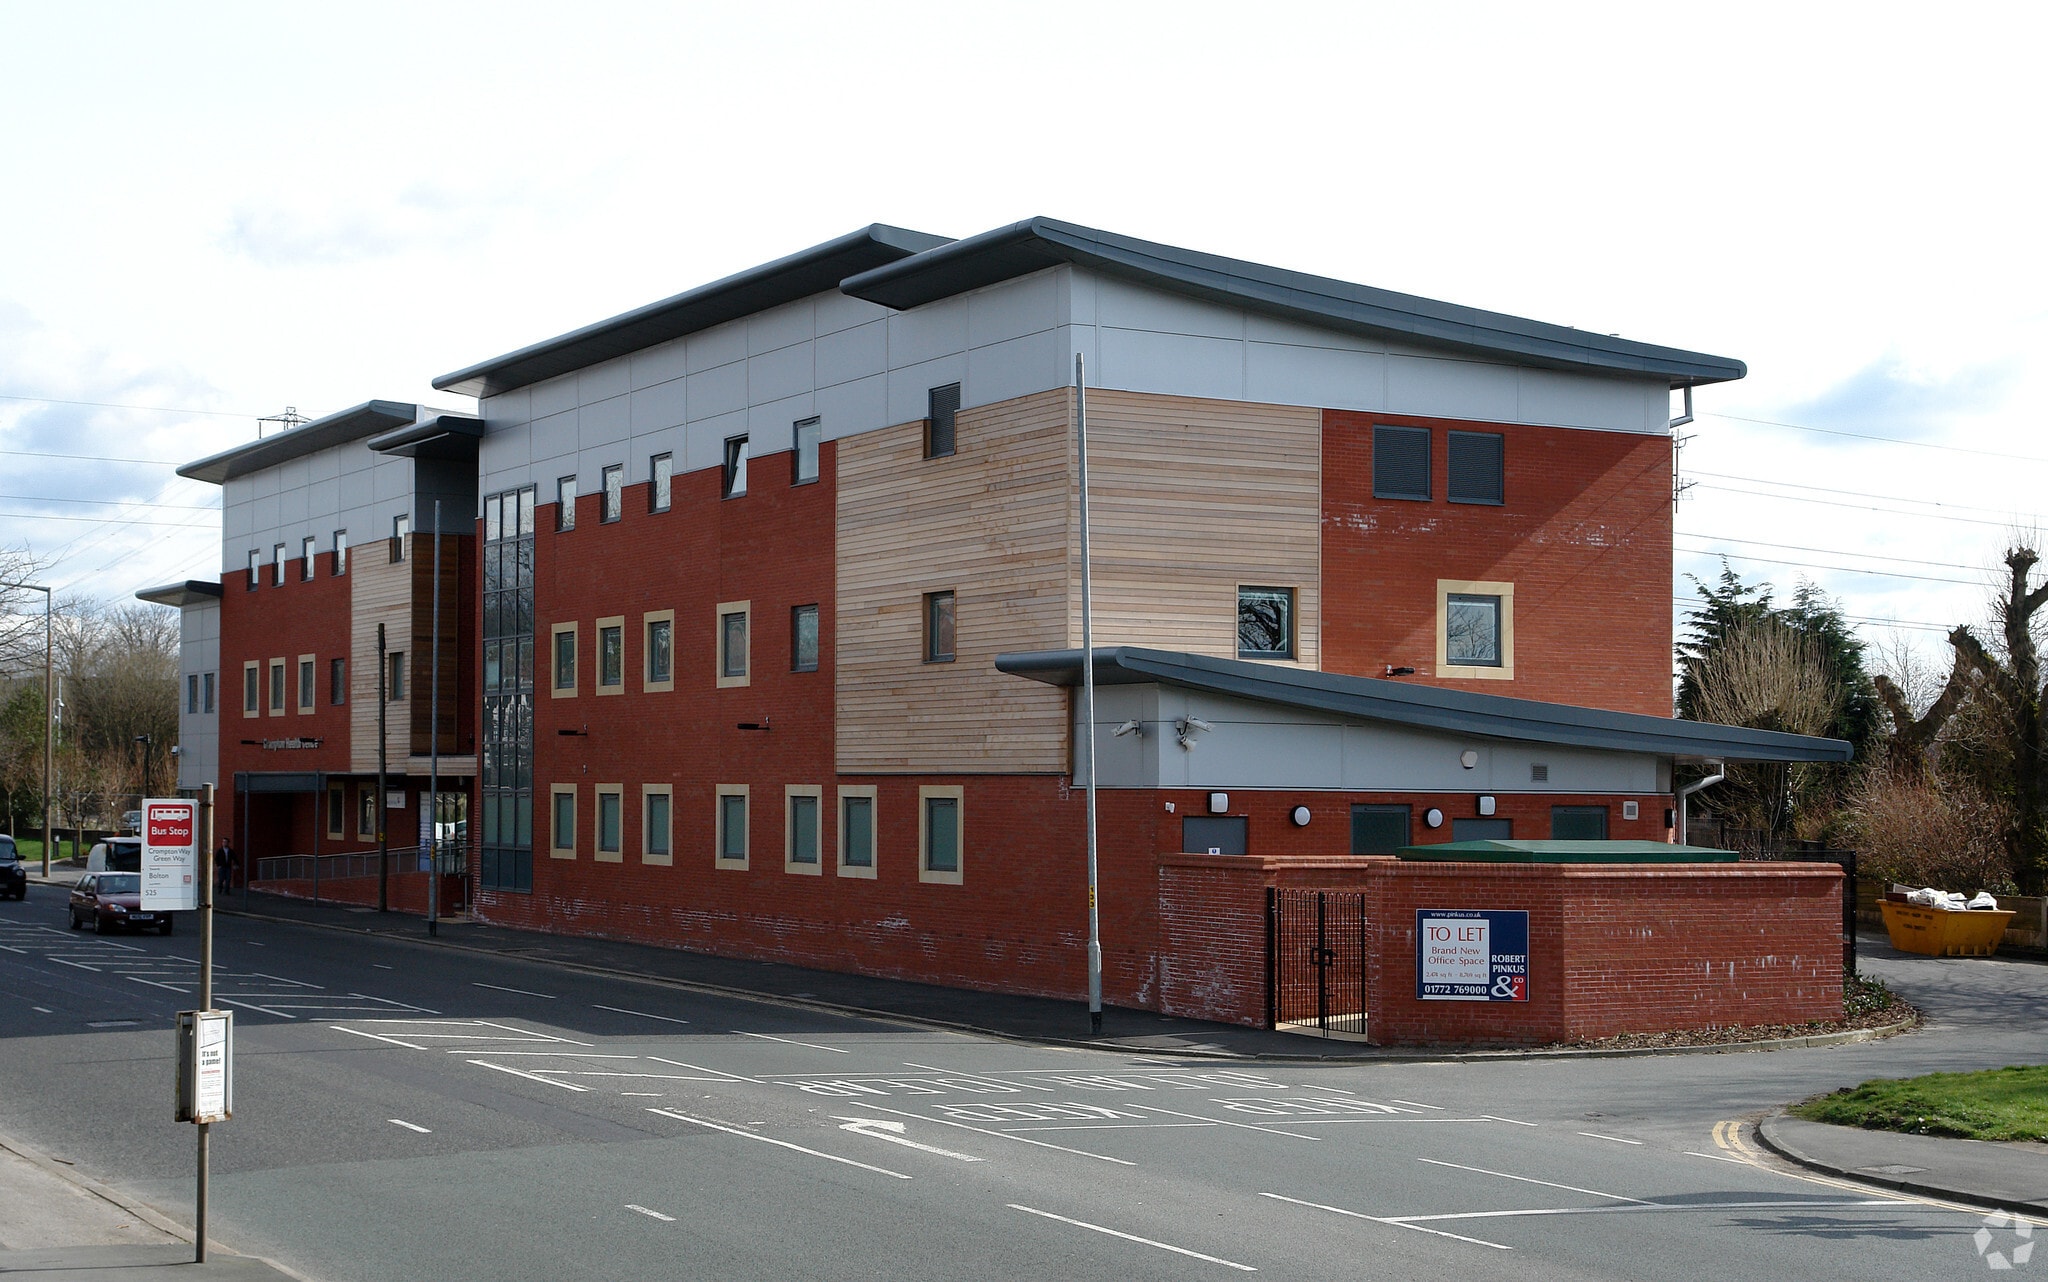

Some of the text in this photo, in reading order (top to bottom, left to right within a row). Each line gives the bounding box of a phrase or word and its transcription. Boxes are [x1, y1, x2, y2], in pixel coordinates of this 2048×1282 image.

[152, 826, 189, 837] Bus Stop
[148, 848, 191, 857] Crompton Way
[172, 855, 186, 863] Way
[1427, 926, 1486, 942] TO LET
[1431, 946, 1481, 955] Brand New
[1428, 956, 1485, 966] Office Space
[1491, 954, 1526, 963] ROBERT
[1492, 964, 1525, 973] PINKUS
[1424, 984, 1487, 994] 01772 769000
[772, 1078, 1022, 1096] CLEAR
[930, 1101, 1149, 1121] KEEP
[1207, 1097, 1424, 1115] KEEP
